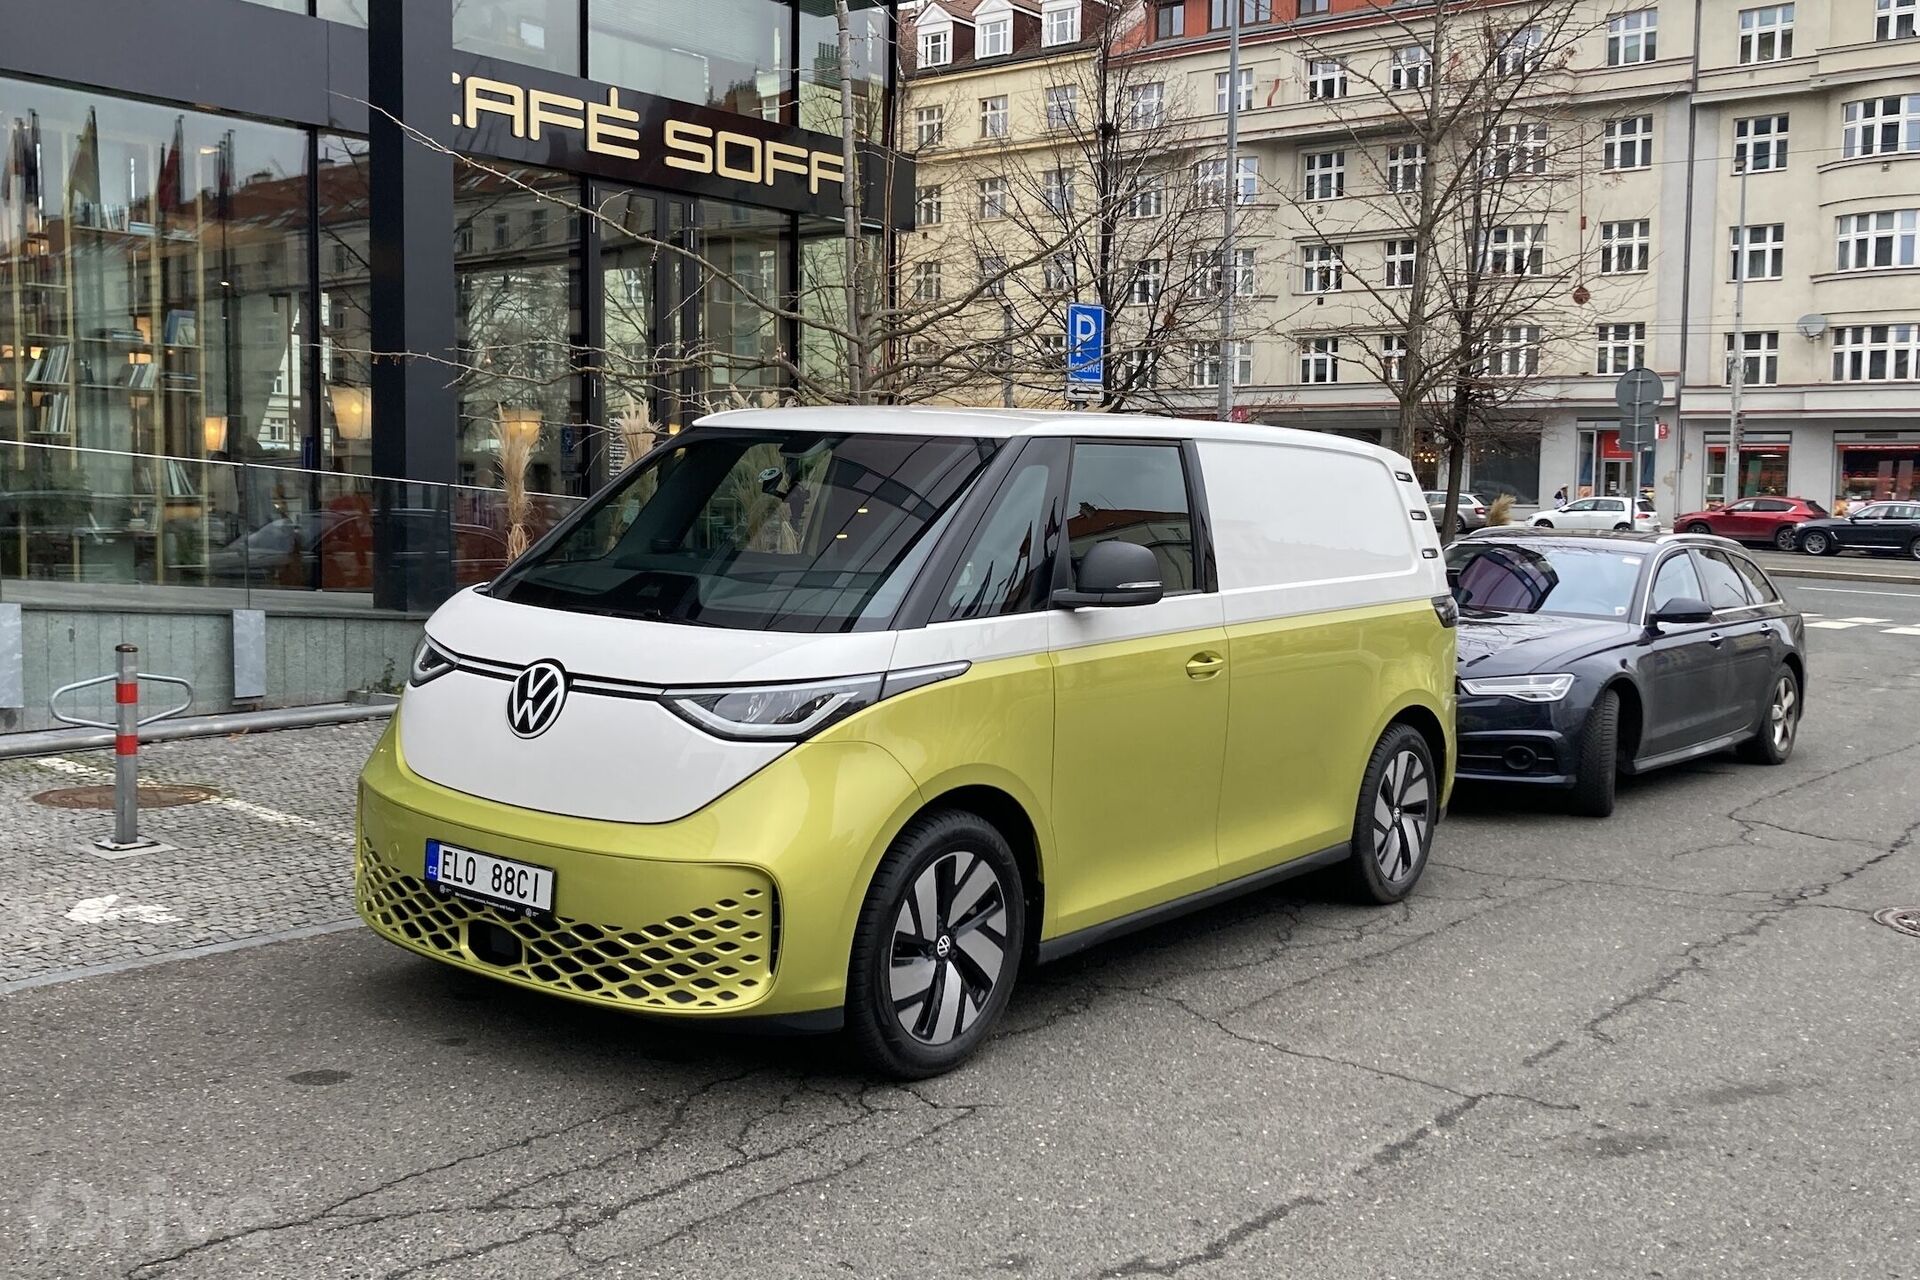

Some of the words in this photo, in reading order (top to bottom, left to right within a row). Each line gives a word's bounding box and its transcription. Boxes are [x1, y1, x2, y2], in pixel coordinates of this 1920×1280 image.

[452, 73, 640, 160] AFÉ
[1076, 314, 1096, 357] P
[428, 865, 438, 876] CZ
